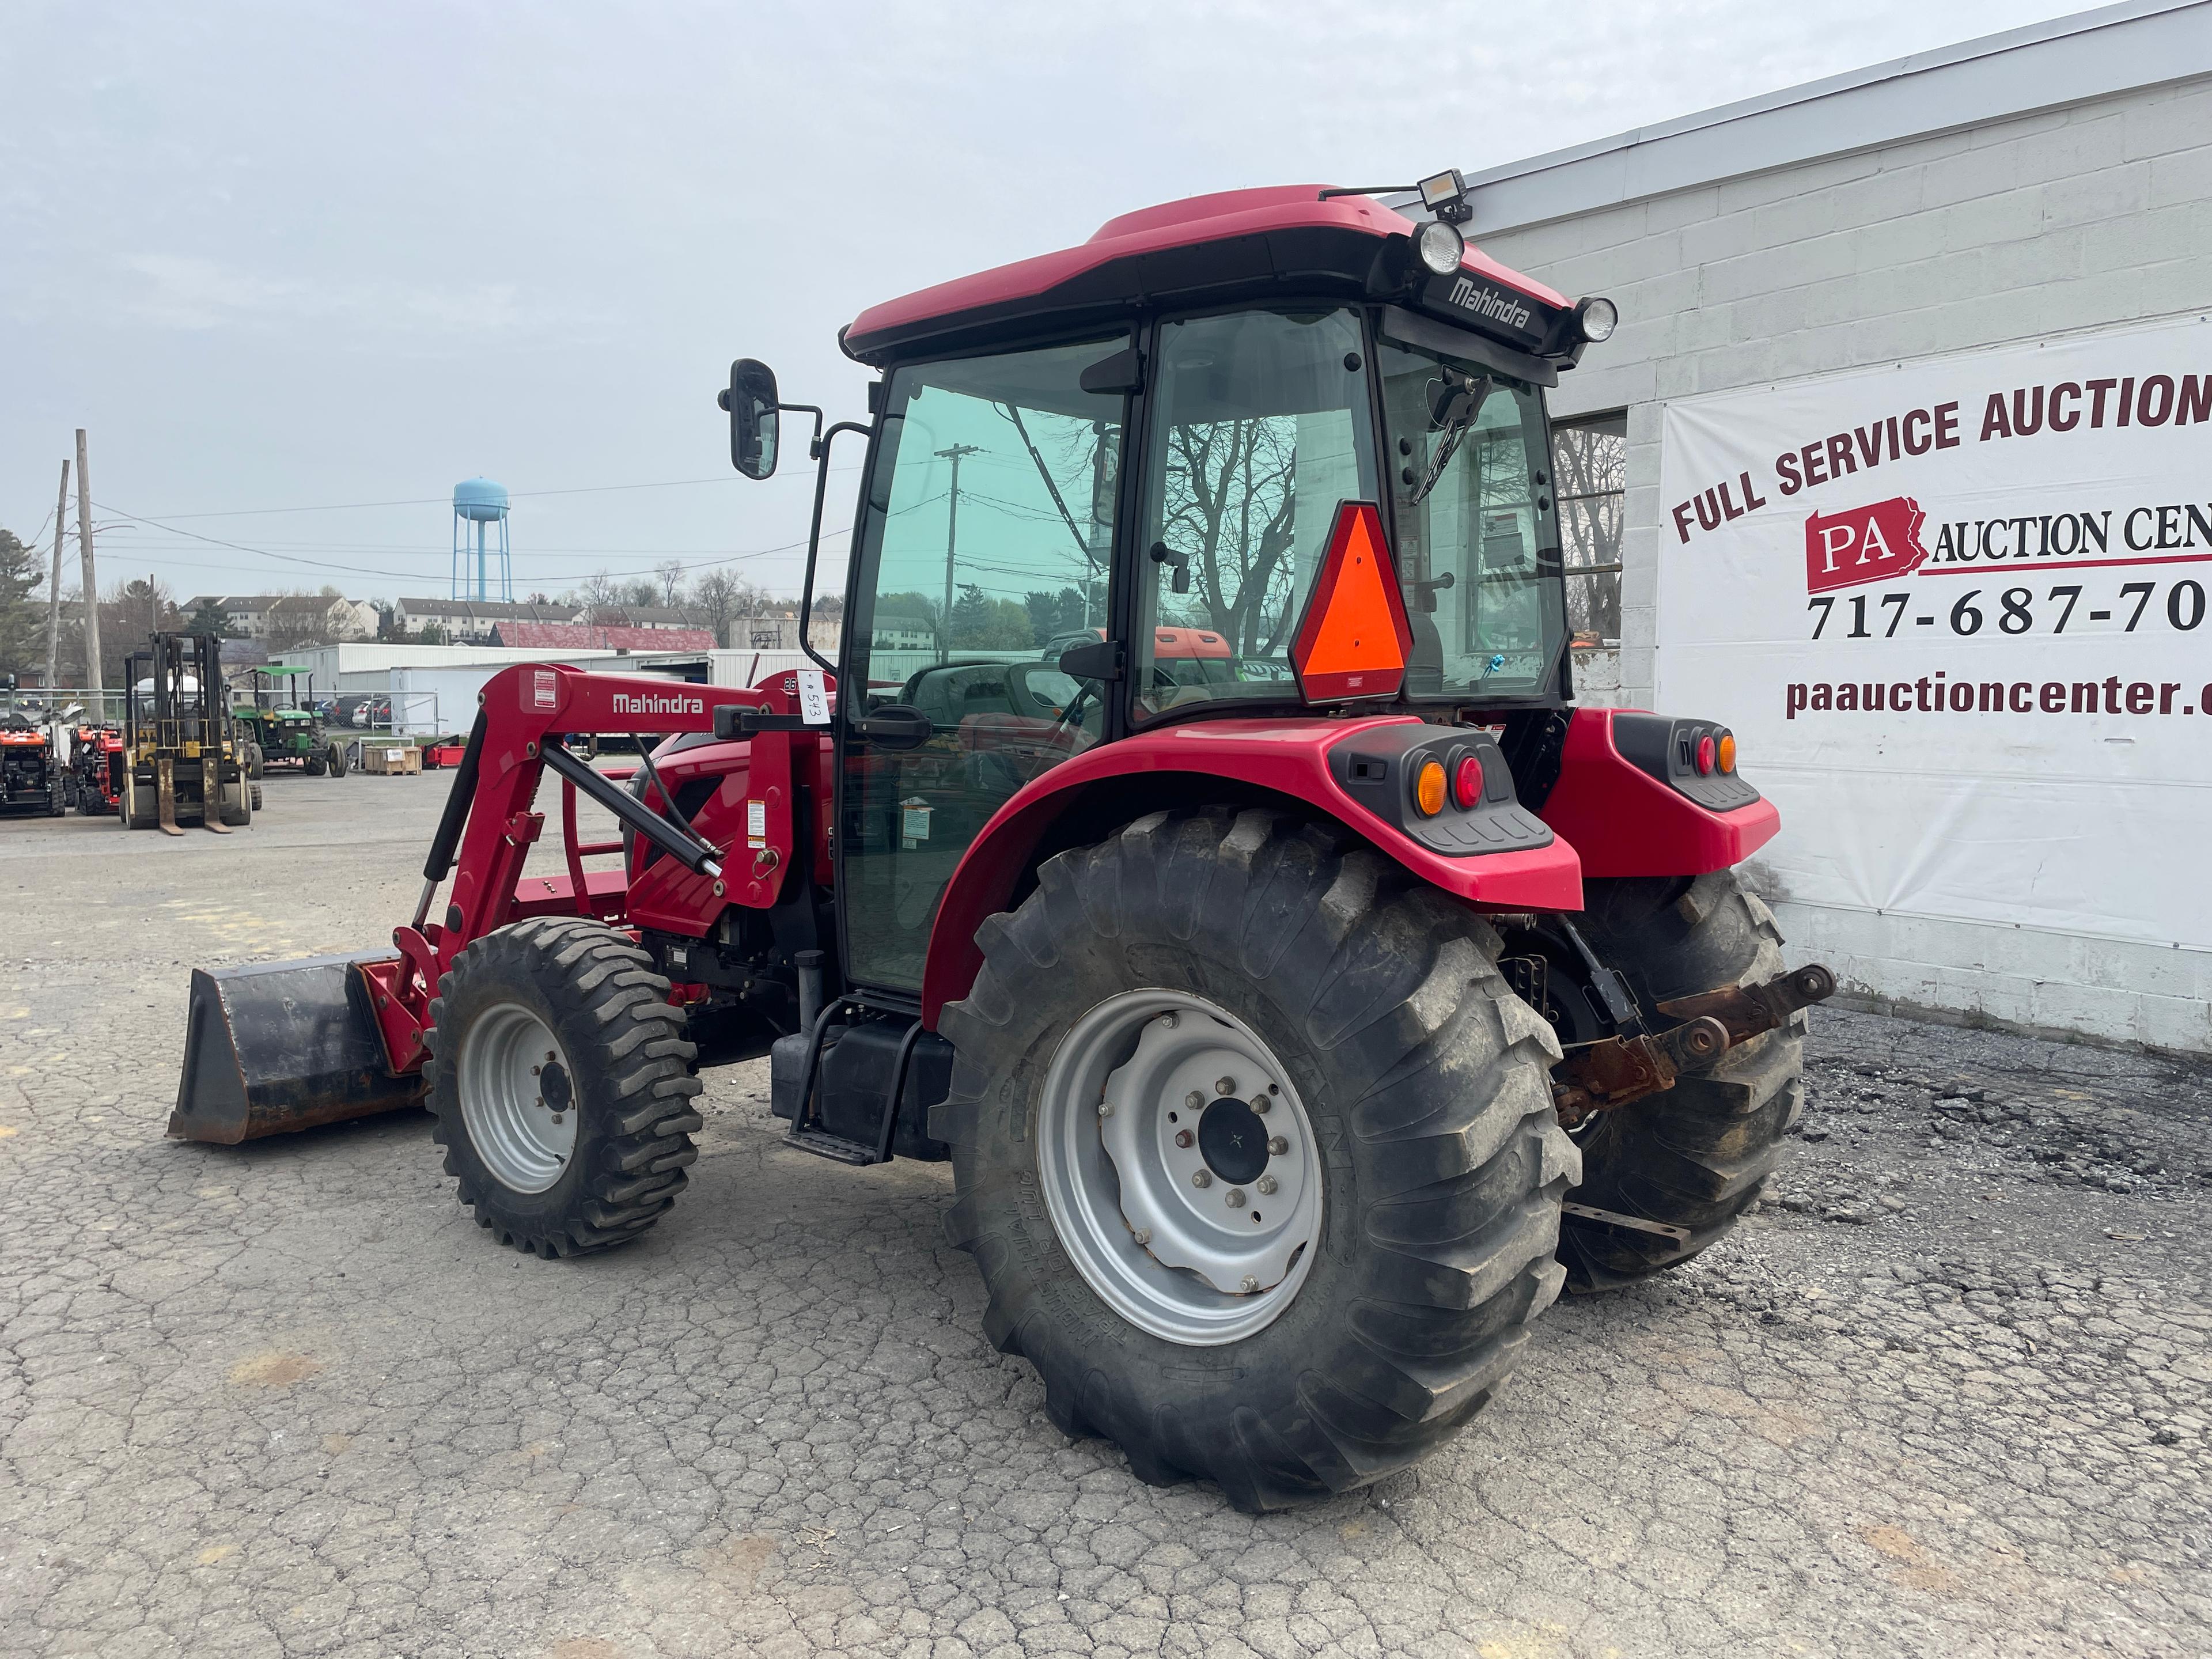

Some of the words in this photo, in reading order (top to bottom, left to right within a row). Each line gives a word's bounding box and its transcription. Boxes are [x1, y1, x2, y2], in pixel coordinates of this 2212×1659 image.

[1449, 276, 1530, 328] Mahindra
[1672, 471, 1767, 545] FULL
[1776, 401, 1960, 496] SERVICE
[1980, 375, 2212, 441] AUCTION
[1819, 517, 1895, 573] PA
[1933, 511, 2112, 563] AUCTION
[613, 694, 703, 714] Mahindra
[1018, 1169, 1045, 1220] LUG
[1037, 1236, 1127, 1346] TRACTOR
